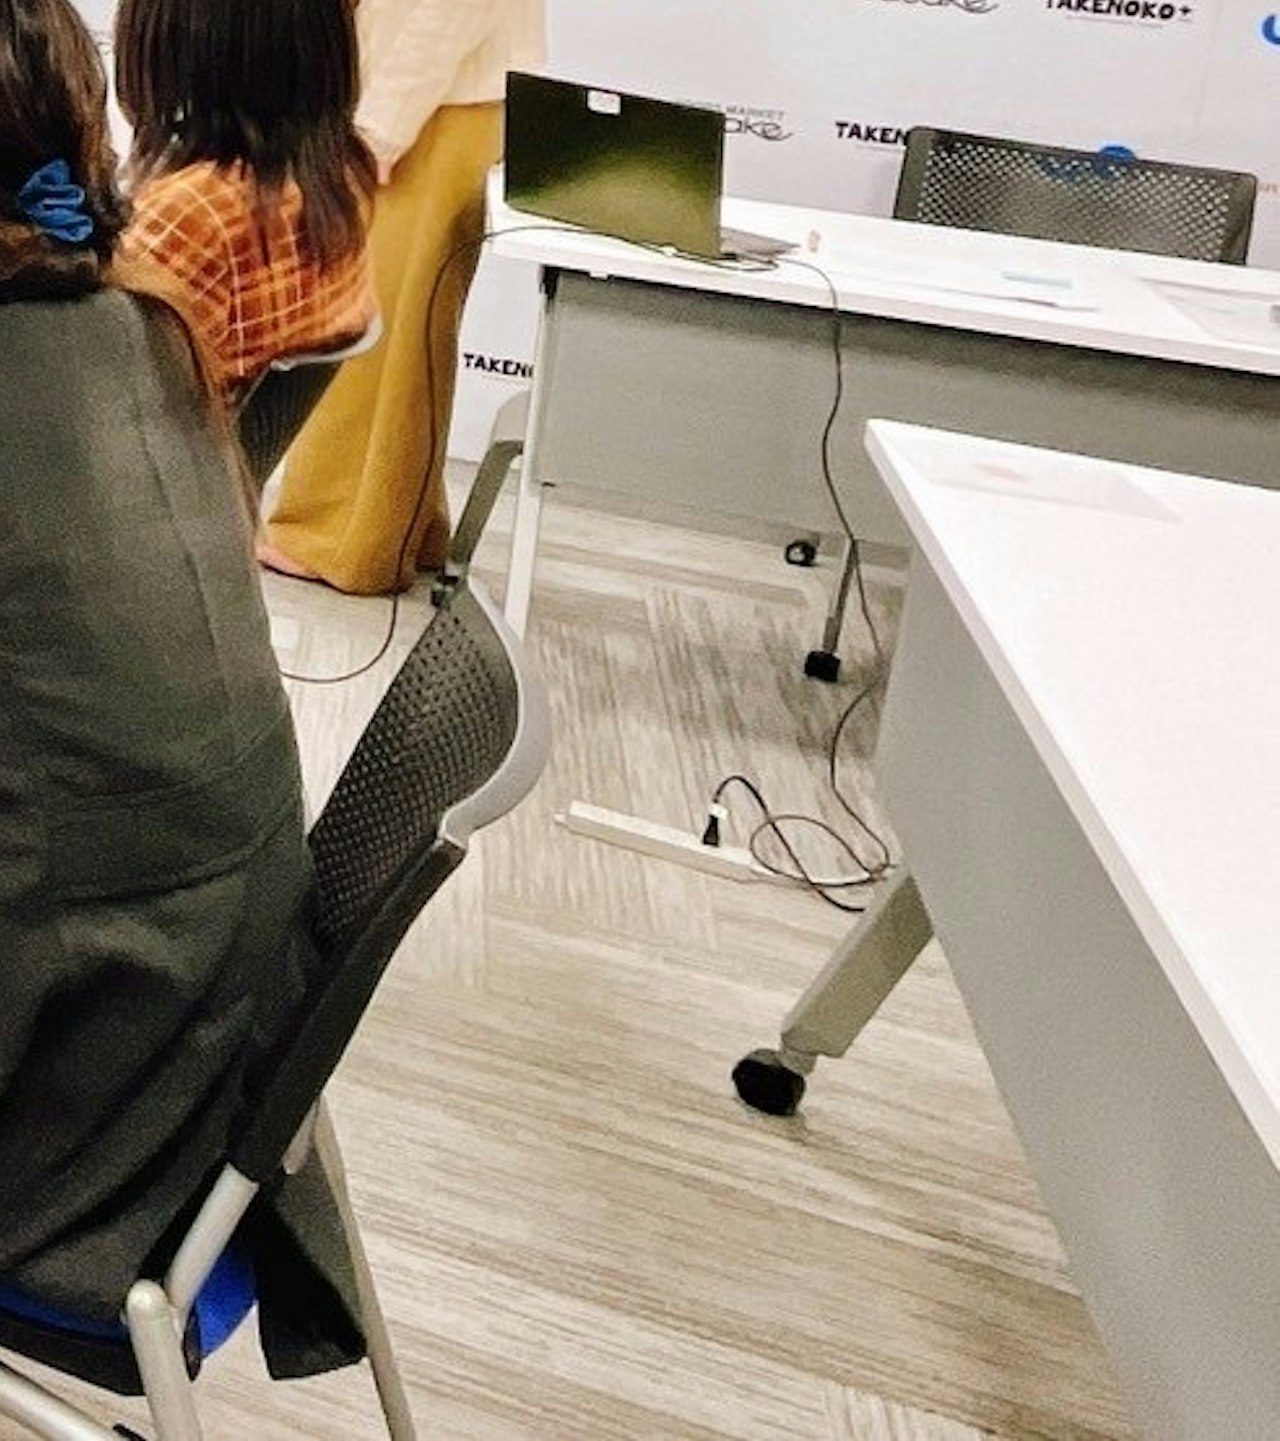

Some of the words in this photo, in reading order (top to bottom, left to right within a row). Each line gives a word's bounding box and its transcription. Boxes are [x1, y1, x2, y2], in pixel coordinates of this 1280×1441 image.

[724, 117, 793, 141] ake
[836, 121, 907, 146] TAKEN
[464, 353, 533, 378] TAKEN
